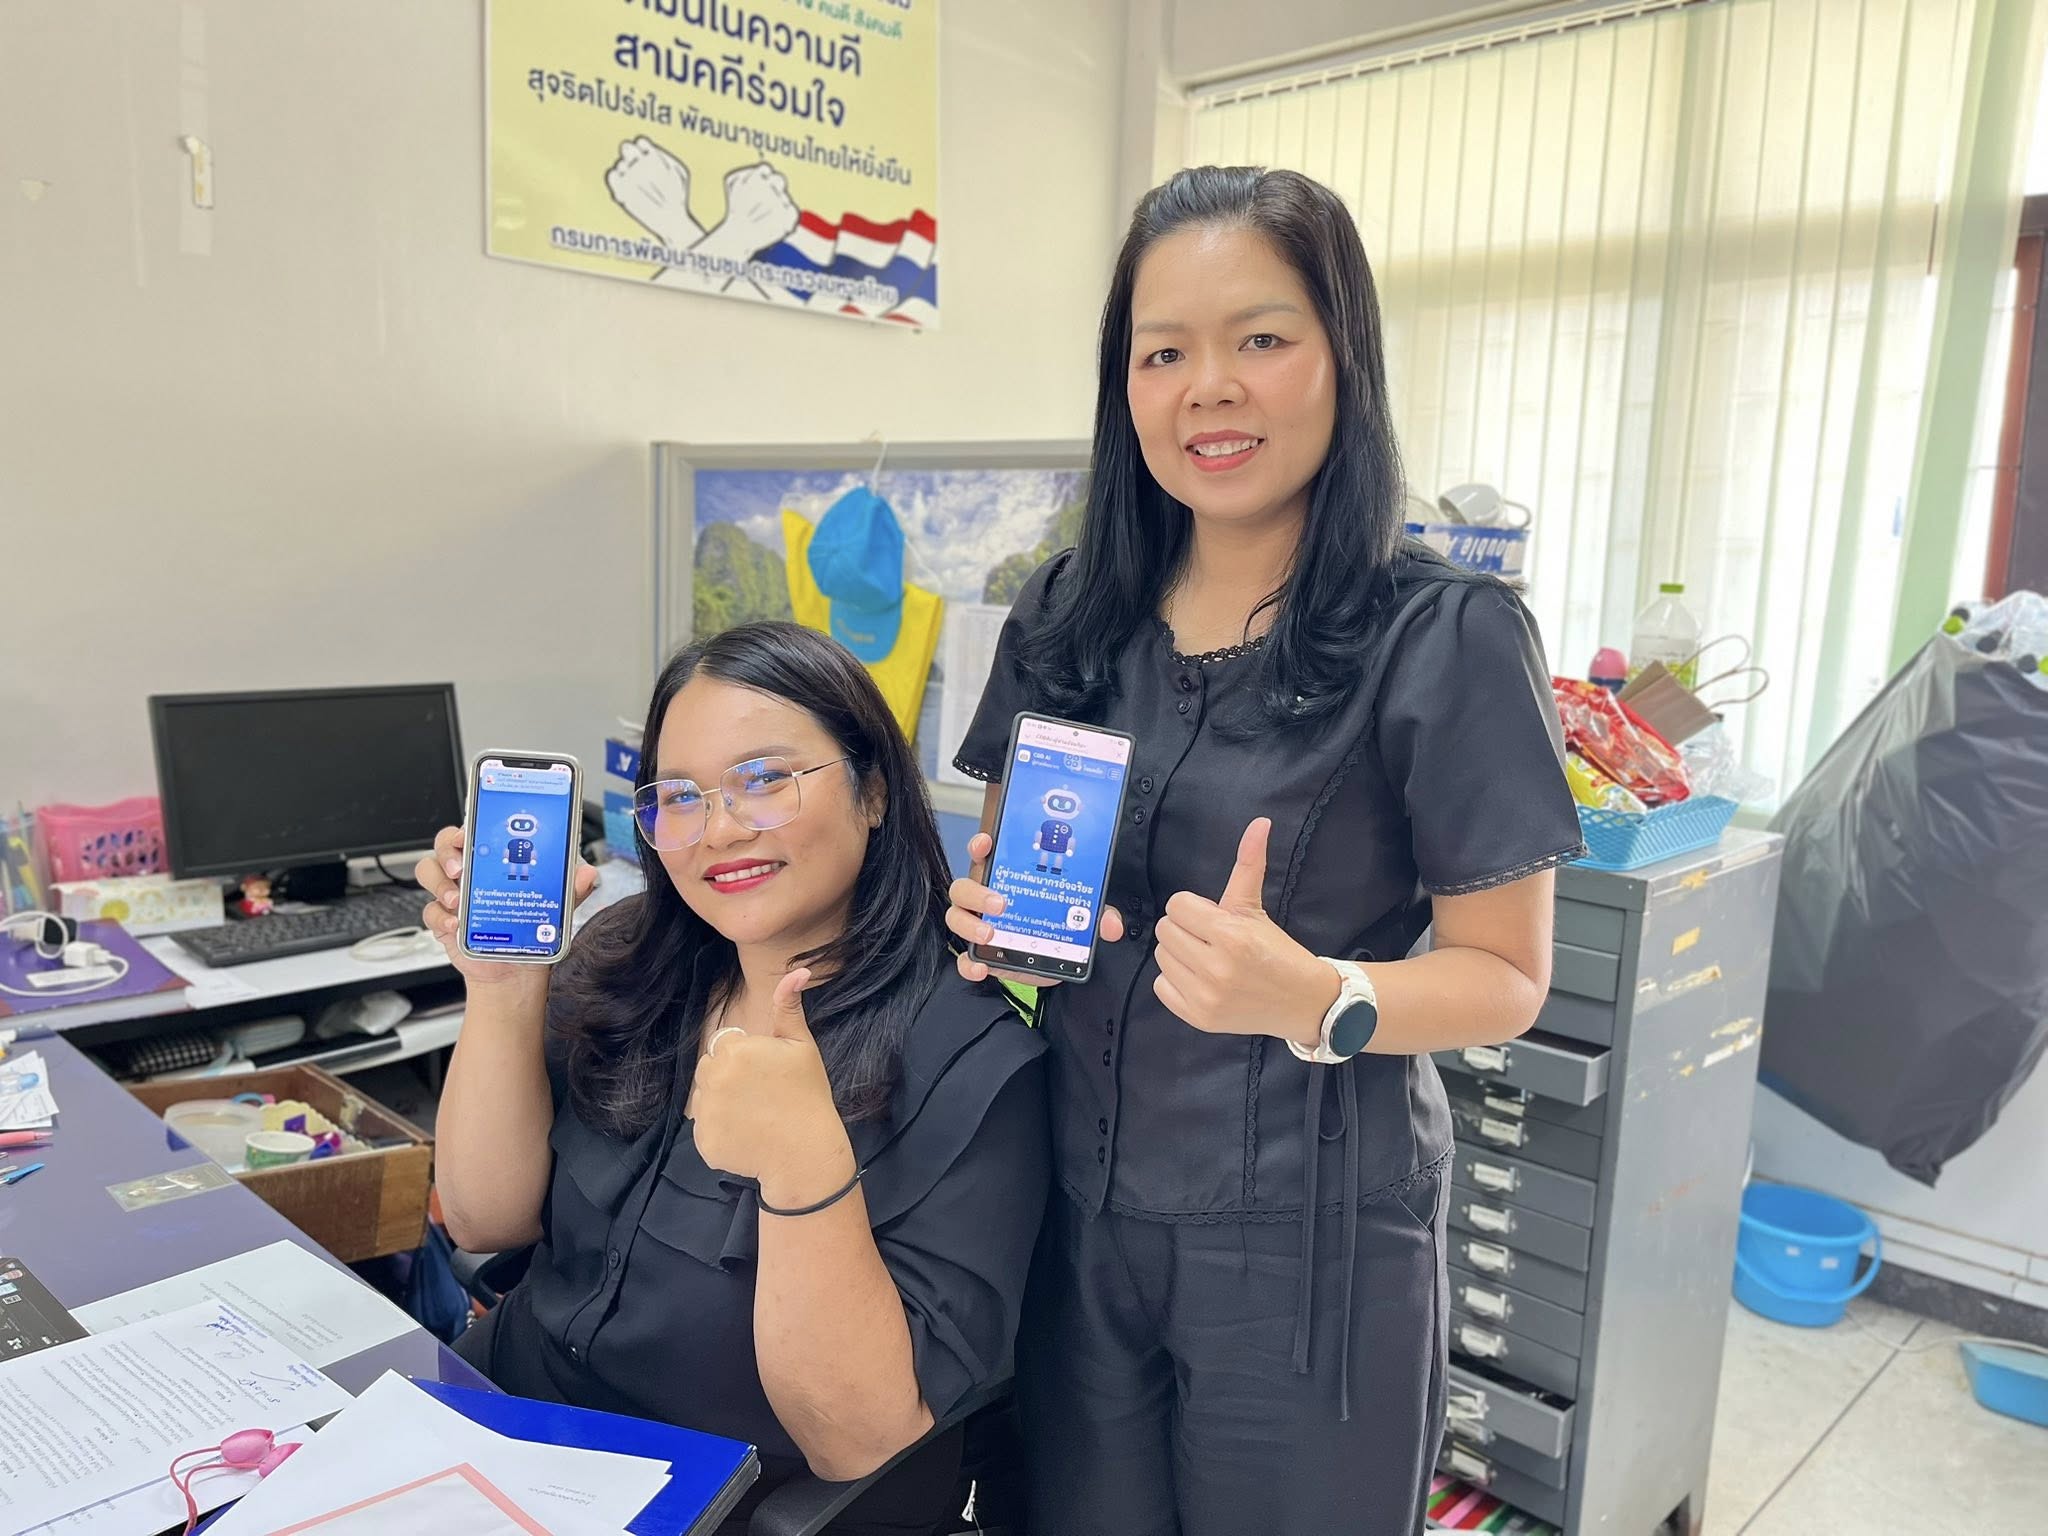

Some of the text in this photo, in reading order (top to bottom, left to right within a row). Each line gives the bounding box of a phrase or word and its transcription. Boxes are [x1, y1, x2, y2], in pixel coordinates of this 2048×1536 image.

[615, 33, 846, 126] สามัคคีร่วมใจ
[528, 68, 912, 185] สุจริตโปร่งใส พัฒนาชุมชนไทยให้ยั่งยืน
[993, 880, 1092, 908] เพื่อชุมชนเข้มแข็งอย่าง
[995, 865, 1094, 894] ผู้ช่วยพัฒนากรอัจฉริยะ
